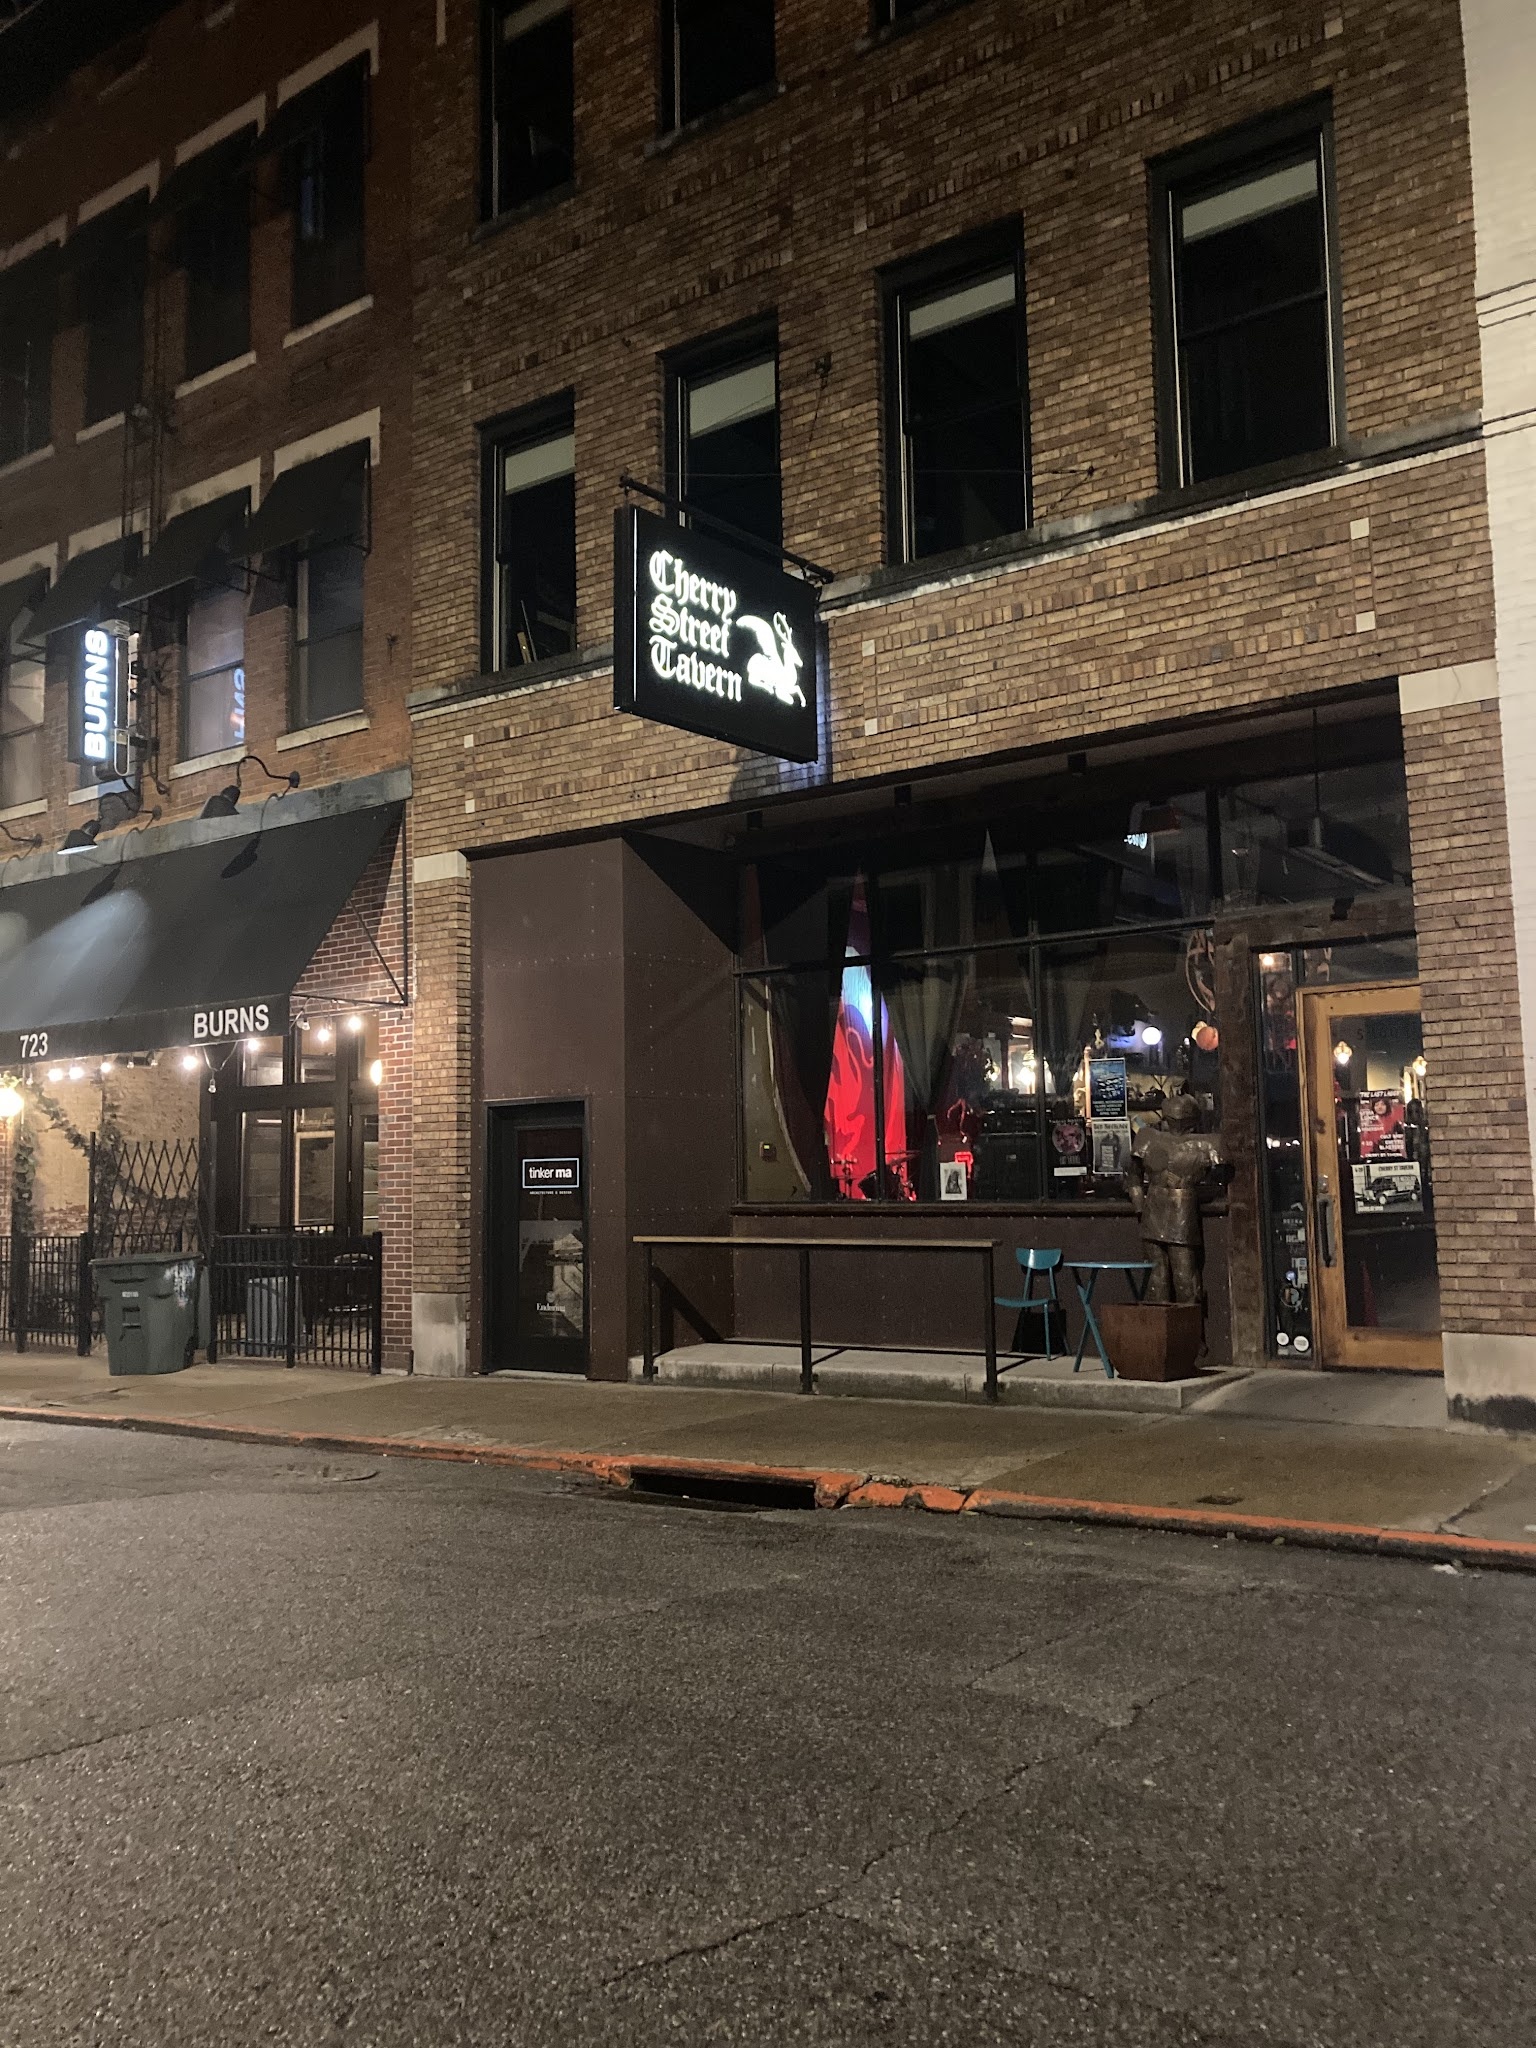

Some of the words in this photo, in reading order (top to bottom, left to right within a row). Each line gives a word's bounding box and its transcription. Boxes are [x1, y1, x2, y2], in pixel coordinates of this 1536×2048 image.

[649, 550, 737, 624] Cherry
[649, 593, 733, 658] Street
[84, 629, 108, 759] BURNS
[649, 635, 742, 702] Tavern
[19, 1032, 49, 1058] 723
[193, 1004, 270, 1039] BURNS
[529, 1167, 555, 1178] tinker
[555, 1168, 572, 1178] ma
